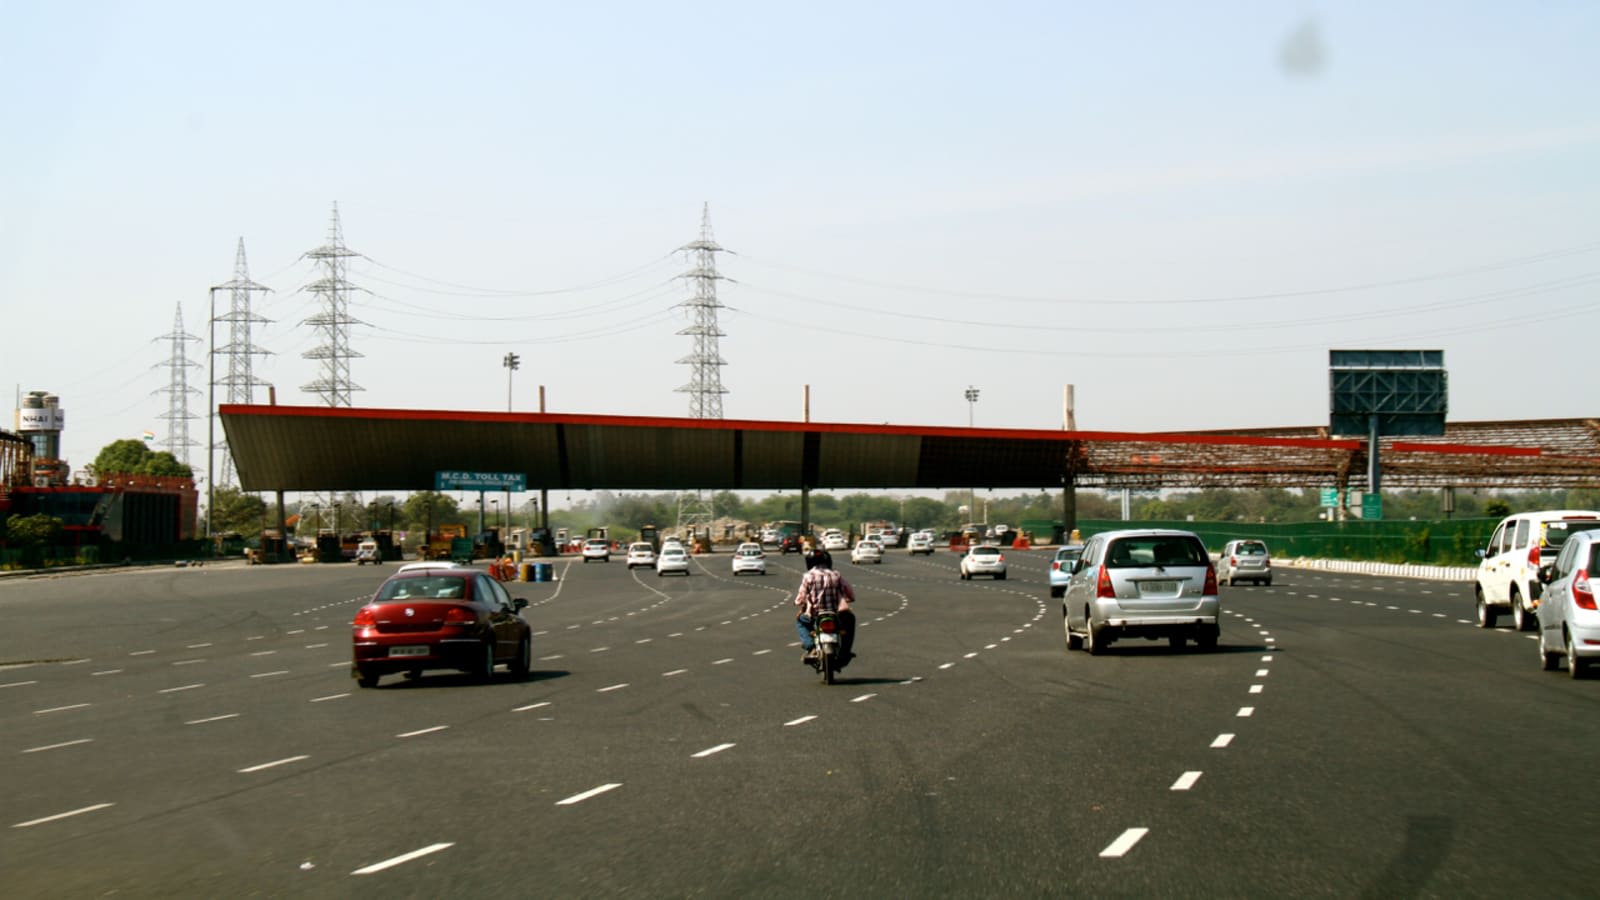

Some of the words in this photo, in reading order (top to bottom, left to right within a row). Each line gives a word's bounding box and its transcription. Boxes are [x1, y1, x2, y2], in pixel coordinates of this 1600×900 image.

[22, 415, 48, 423] NHAI
[474, 473, 499, 481] TOLL
[503, 473, 521, 481] TAX
